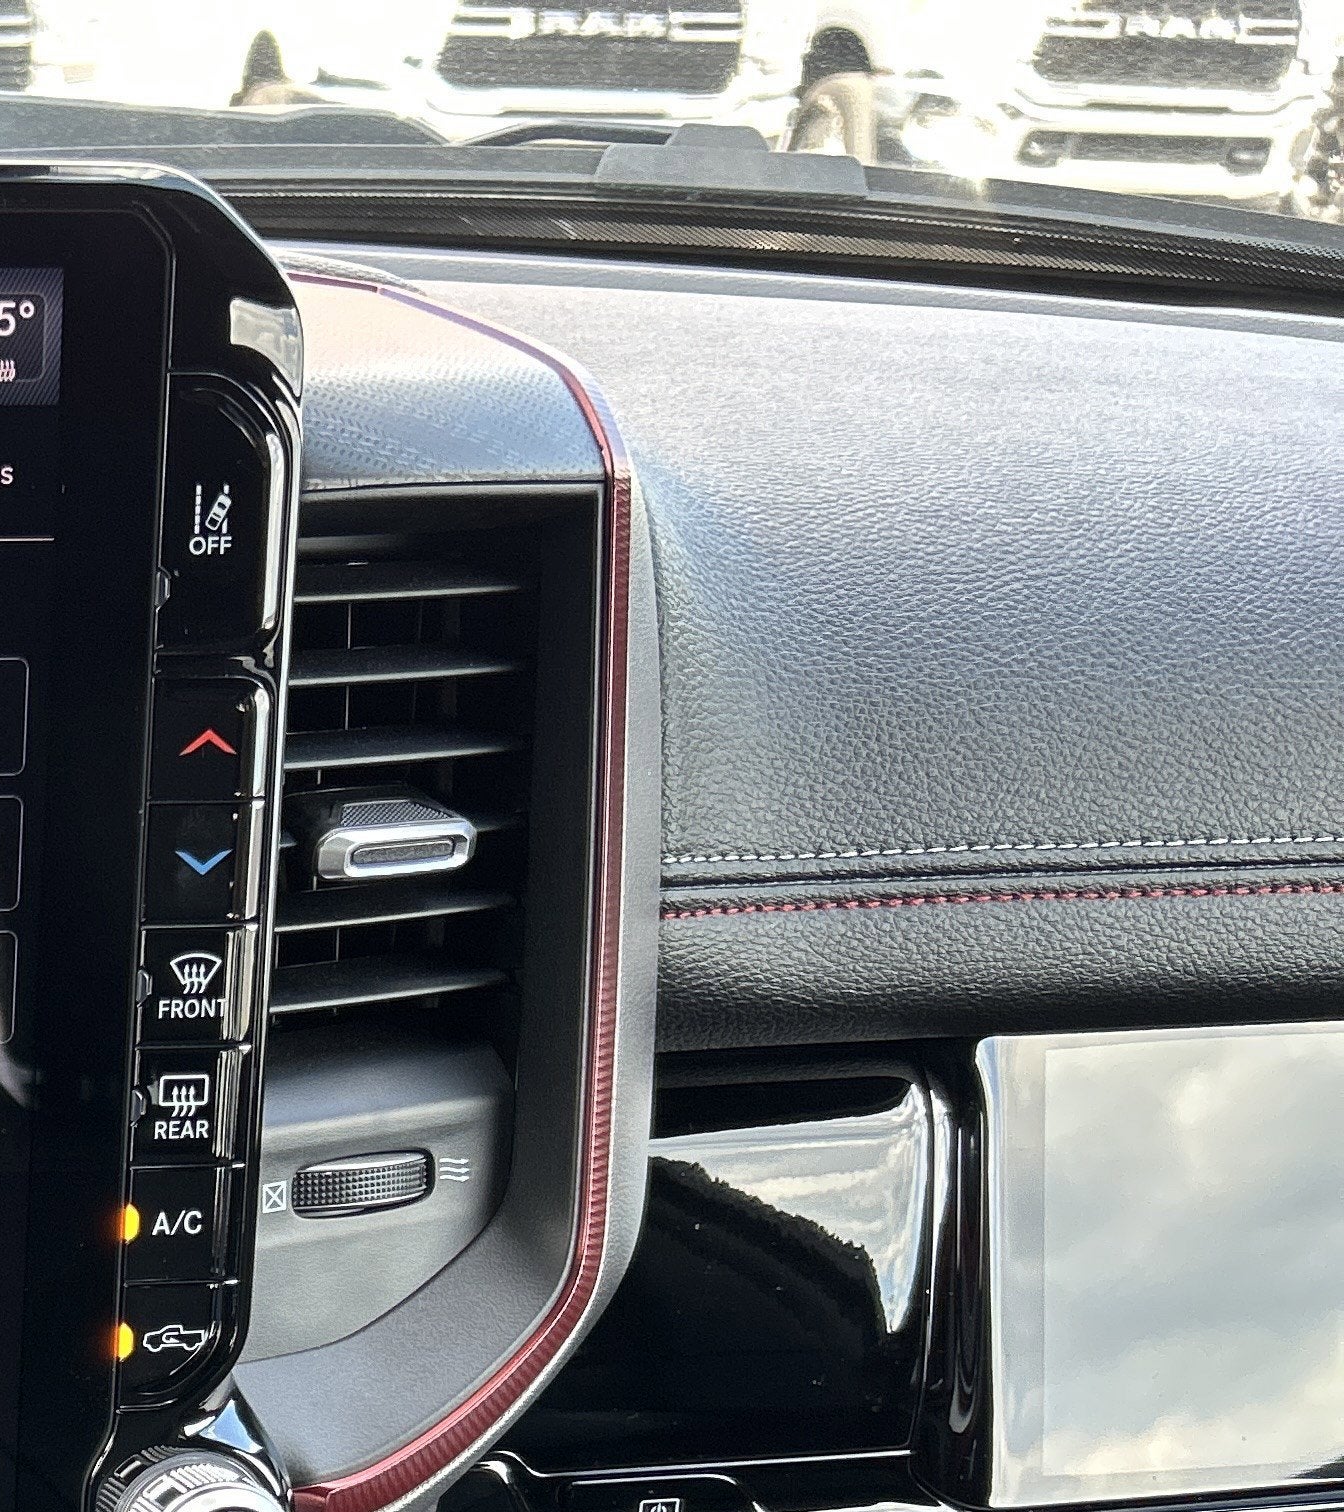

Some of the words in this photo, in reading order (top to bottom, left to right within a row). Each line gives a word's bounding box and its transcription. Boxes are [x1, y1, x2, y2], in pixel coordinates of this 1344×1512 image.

[188, 535, 233, 556] OFF
[156, 998, 226, 1020] FRONT
[153, 1119, 209, 1140] REAR
[151, 1209, 202, 1236] A/C
